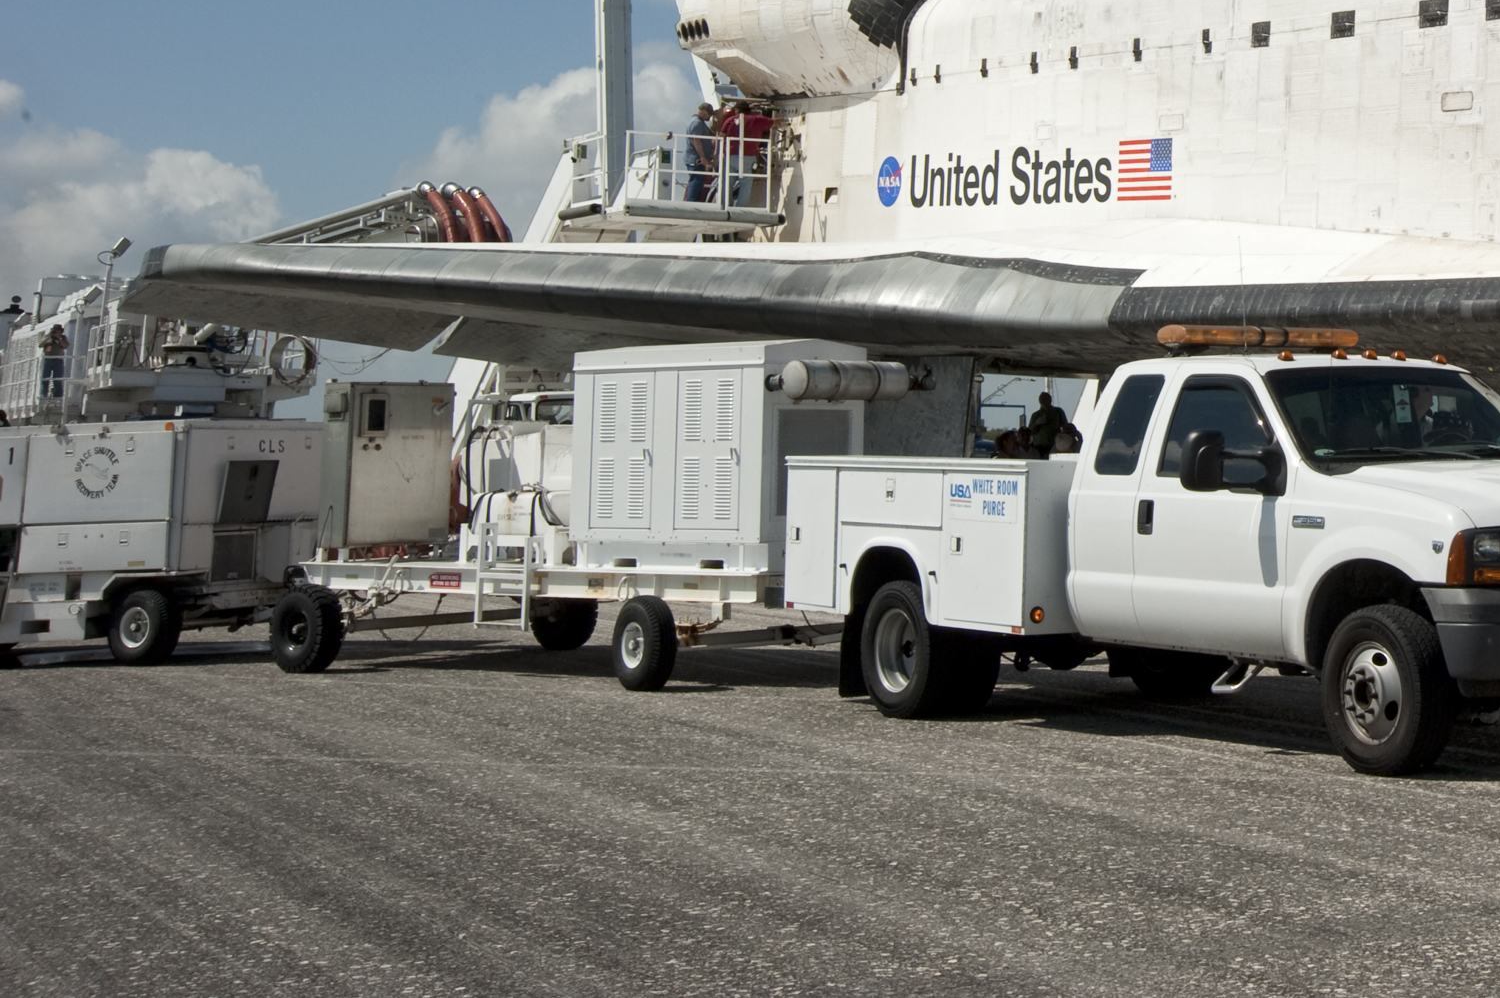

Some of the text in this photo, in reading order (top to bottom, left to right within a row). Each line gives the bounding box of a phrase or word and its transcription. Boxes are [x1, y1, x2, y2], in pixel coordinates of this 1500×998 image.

[878, 176, 901, 188] NASA
[910, 146, 1112, 208] United States
[258, 439, 285, 453] CLS
[75, 446, 120, 472] SPACE SHUTTLE
[75, 474, 120, 499] RECOVERY TEAM
[950, 483, 972, 499] USA
[972, 478, 1018, 496] WHITE ROOM
[982, 500, 1006, 516] PURGE
